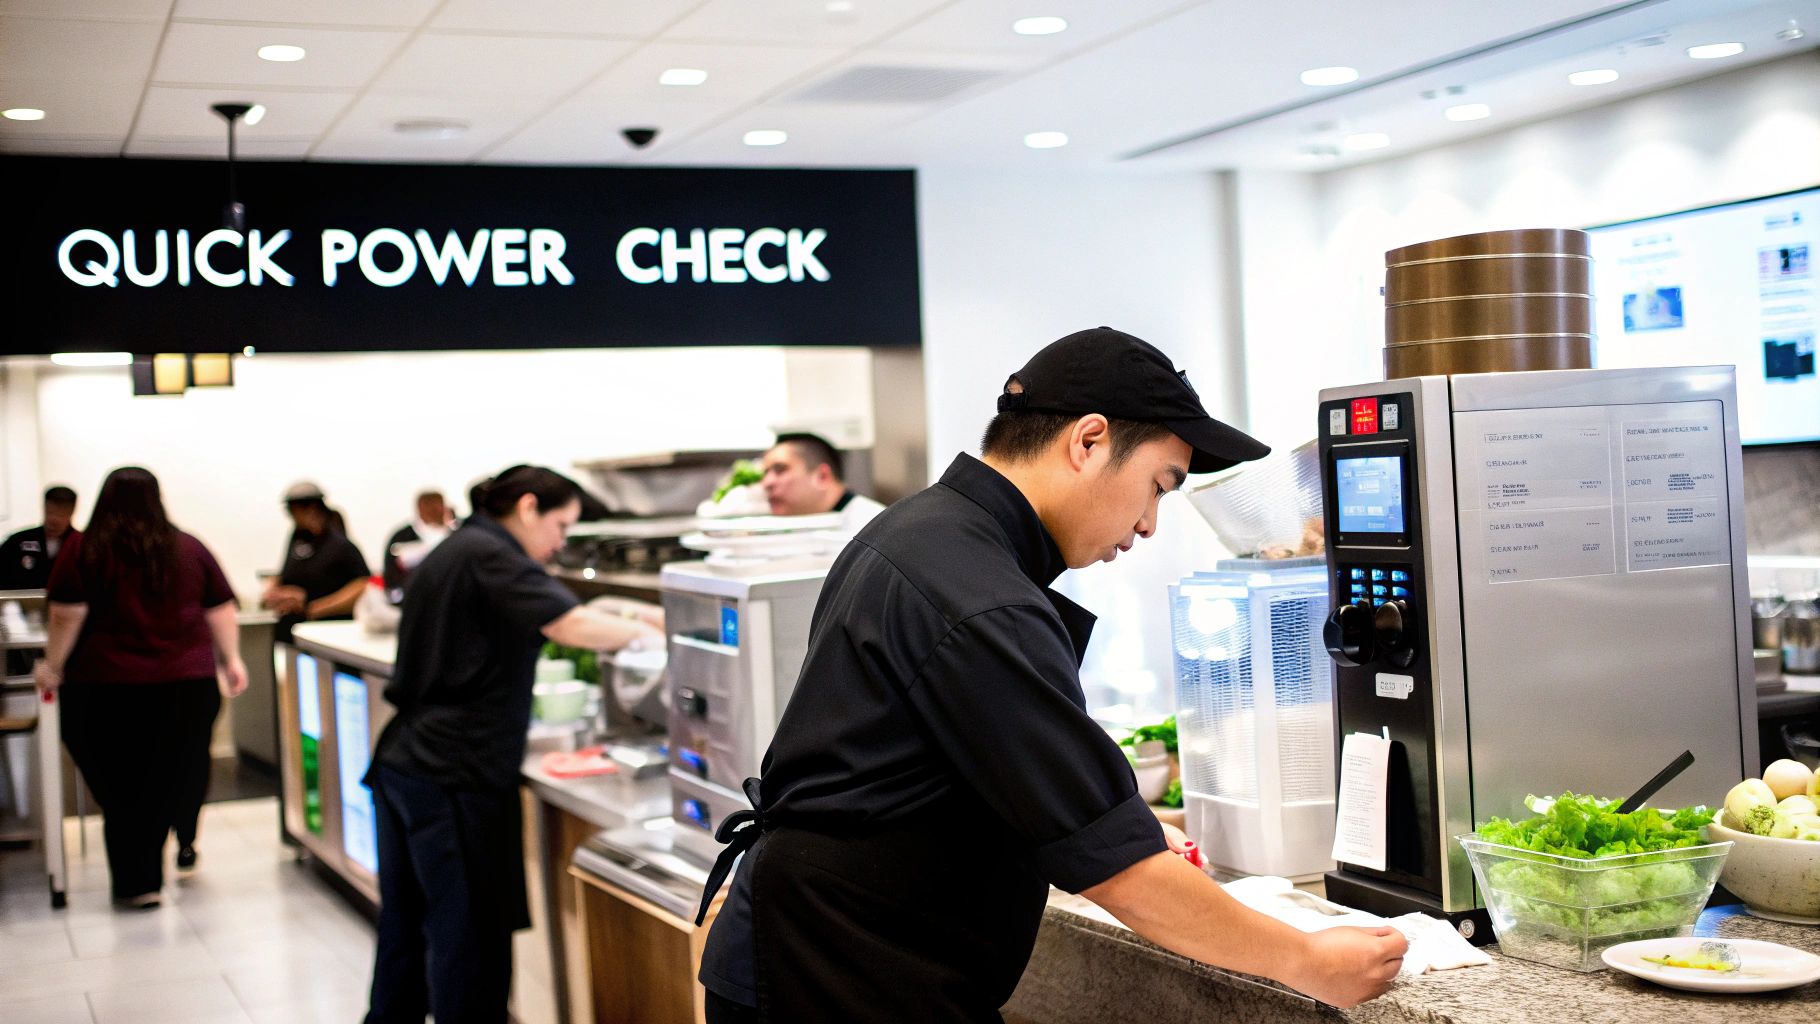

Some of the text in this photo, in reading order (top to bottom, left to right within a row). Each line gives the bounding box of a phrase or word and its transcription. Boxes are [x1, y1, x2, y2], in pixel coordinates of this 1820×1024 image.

[58, 227, 830, 287] QUICK POWER CHECK
